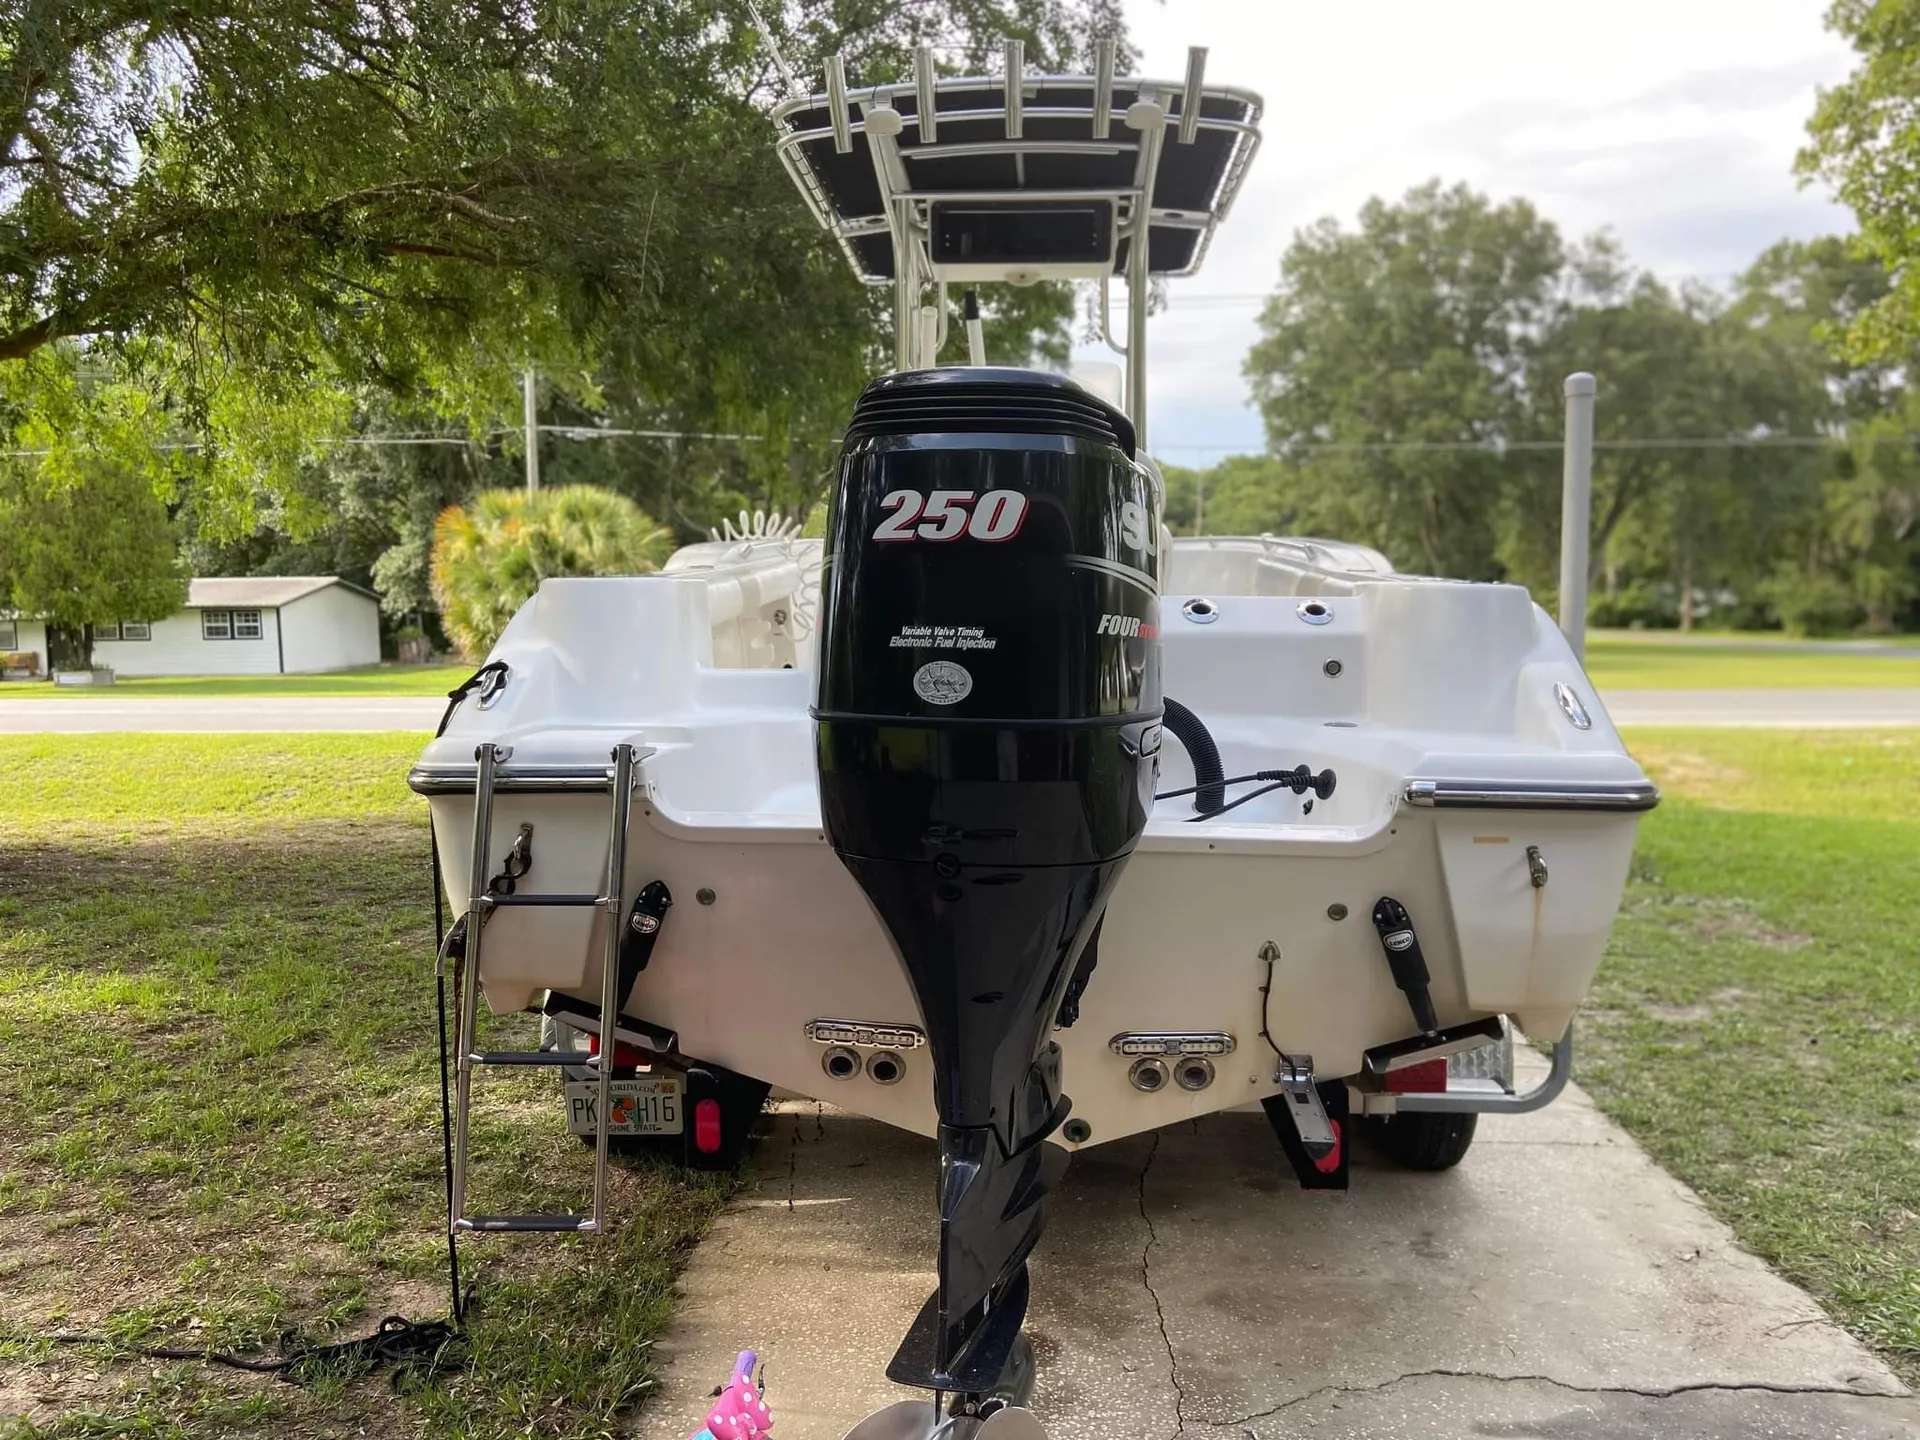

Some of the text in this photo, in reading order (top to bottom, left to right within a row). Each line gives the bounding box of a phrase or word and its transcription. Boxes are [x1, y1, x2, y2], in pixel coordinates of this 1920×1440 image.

[872, 489, 1030, 543] 250
[901, 626, 984, 638] Variable Valve Timing
[1096, 614, 1141, 638] FOUR
[889, 636, 997, 650] Electronic Fuel Injection
[636, 1096, 675, 1122] H16
[633, 1124, 658, 1132] STATE
